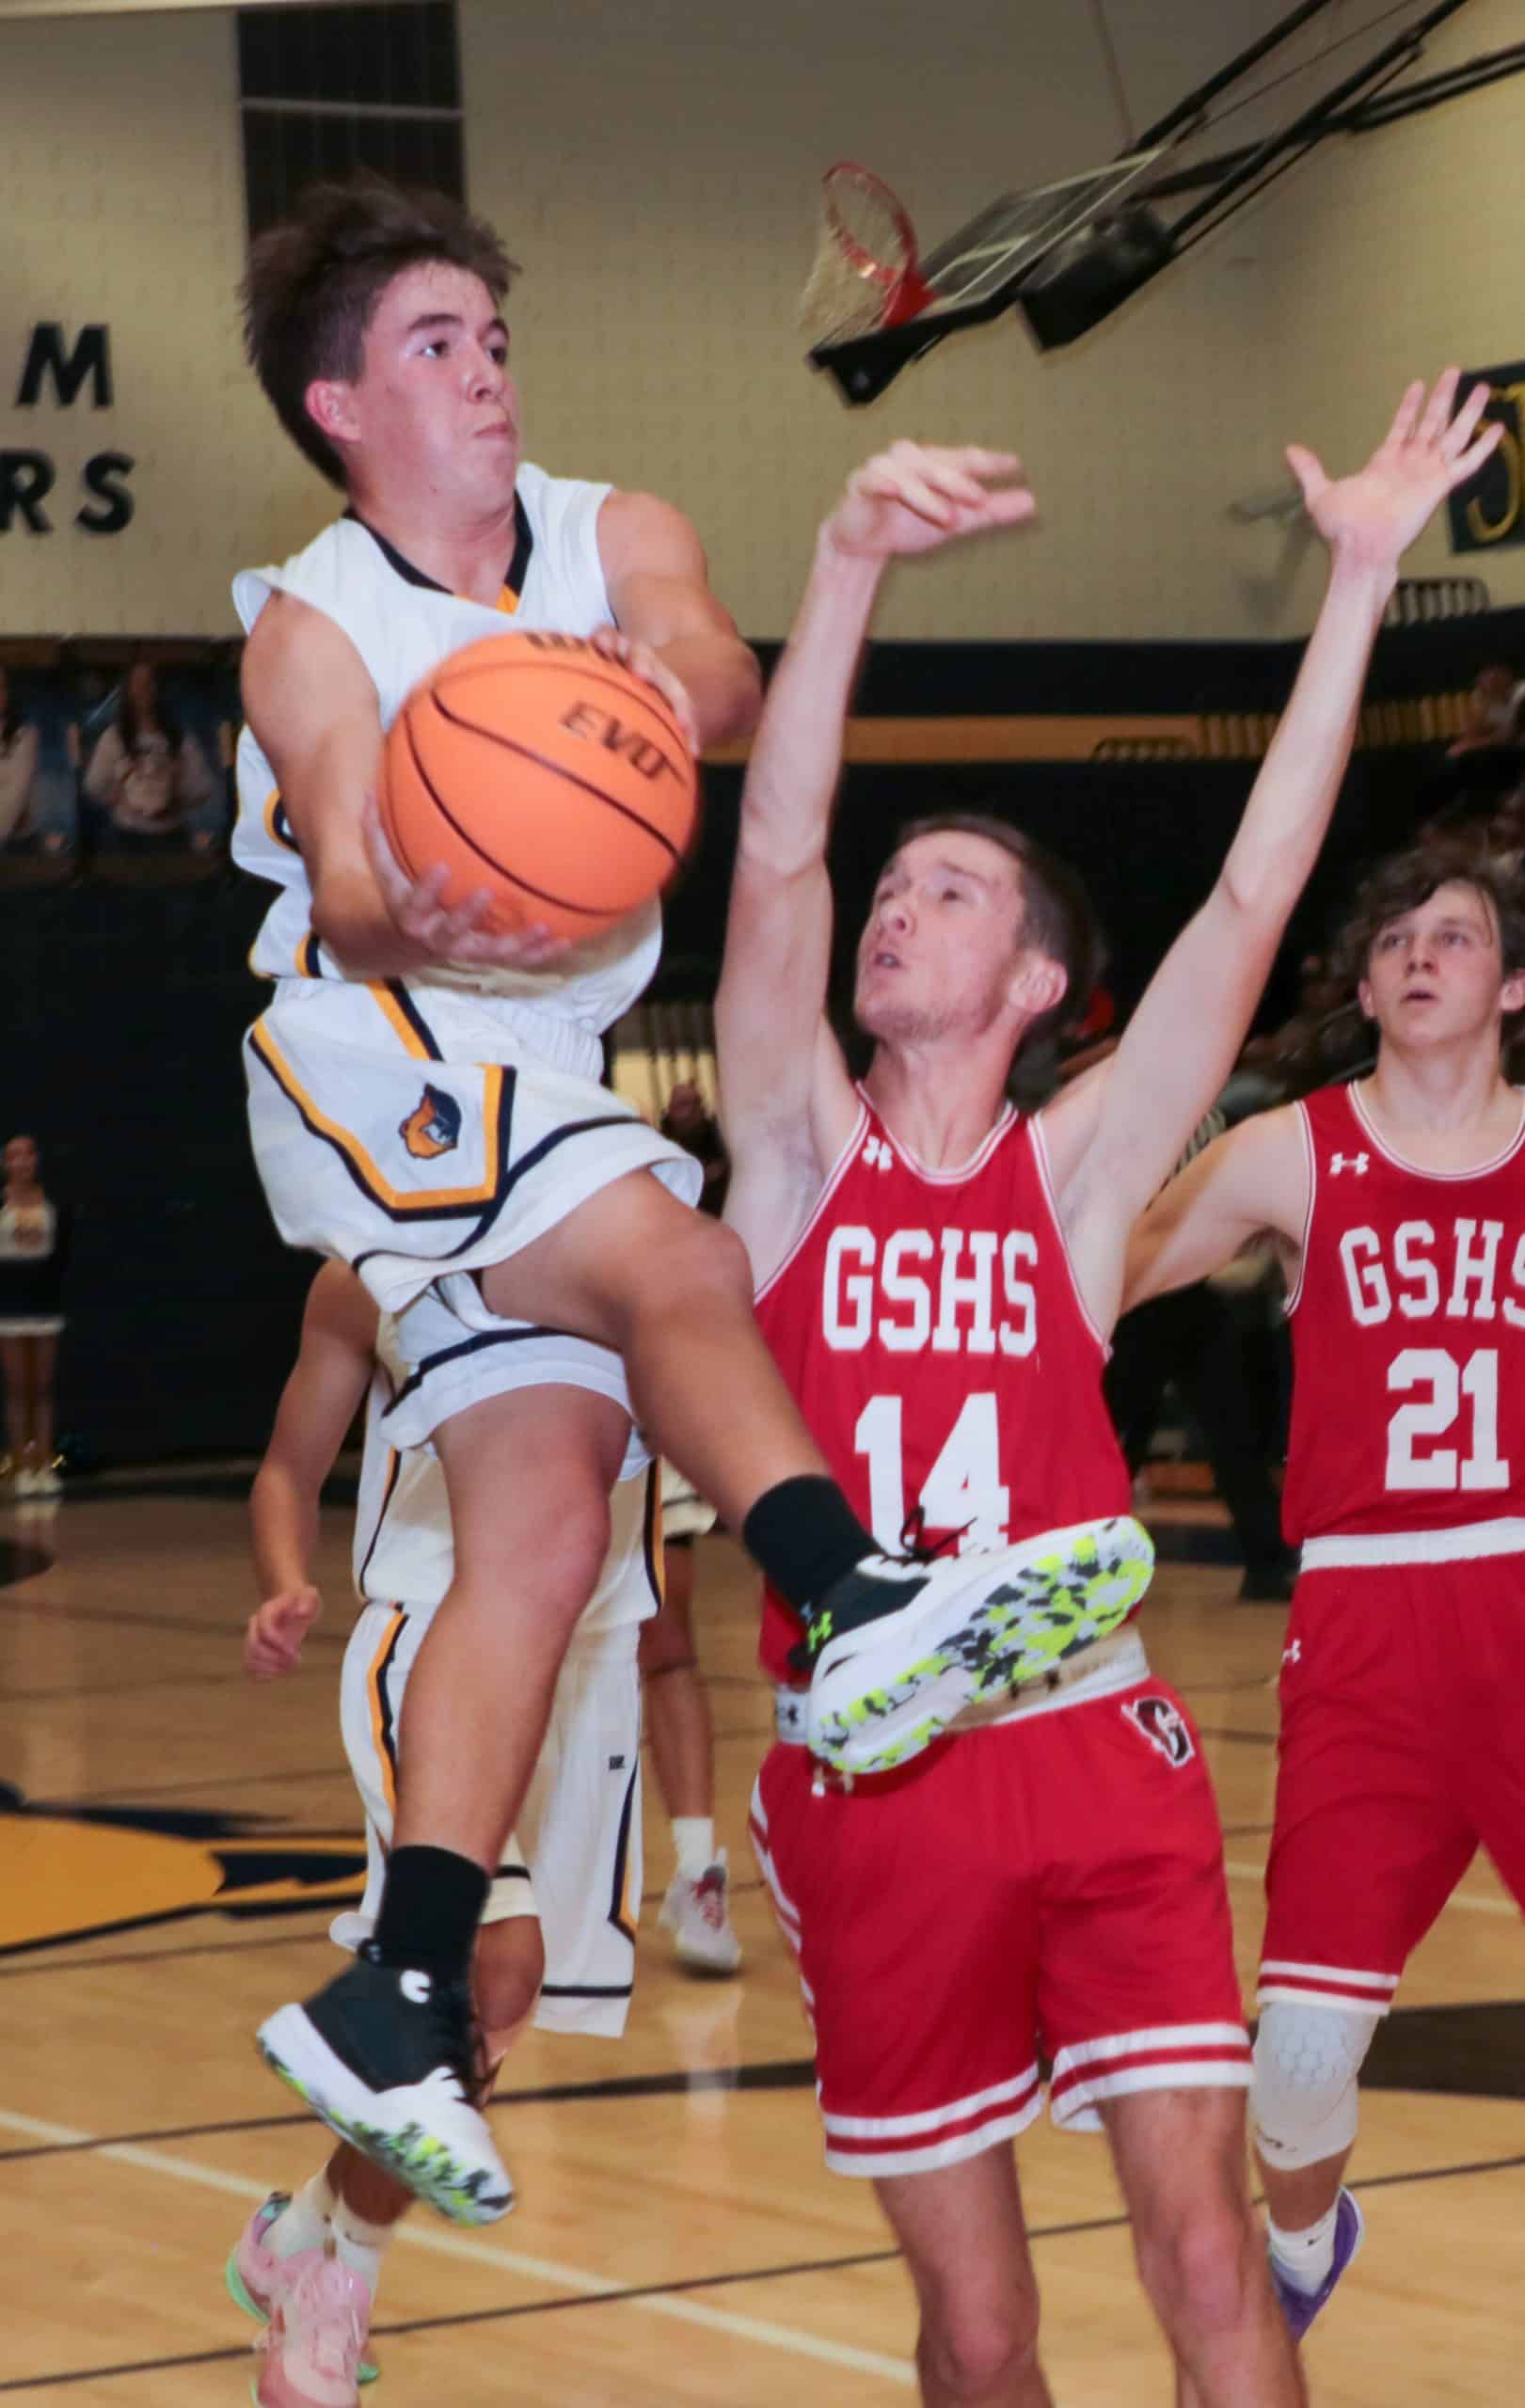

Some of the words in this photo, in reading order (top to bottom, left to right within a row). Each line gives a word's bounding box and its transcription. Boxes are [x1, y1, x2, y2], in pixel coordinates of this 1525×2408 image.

[15, 321, 114, 408] M
[822, 1225, 1038, 1357] GSHS
[854, 1391, 1009, 1558] 14
[1385, 1348, 1510, 1492] 21
